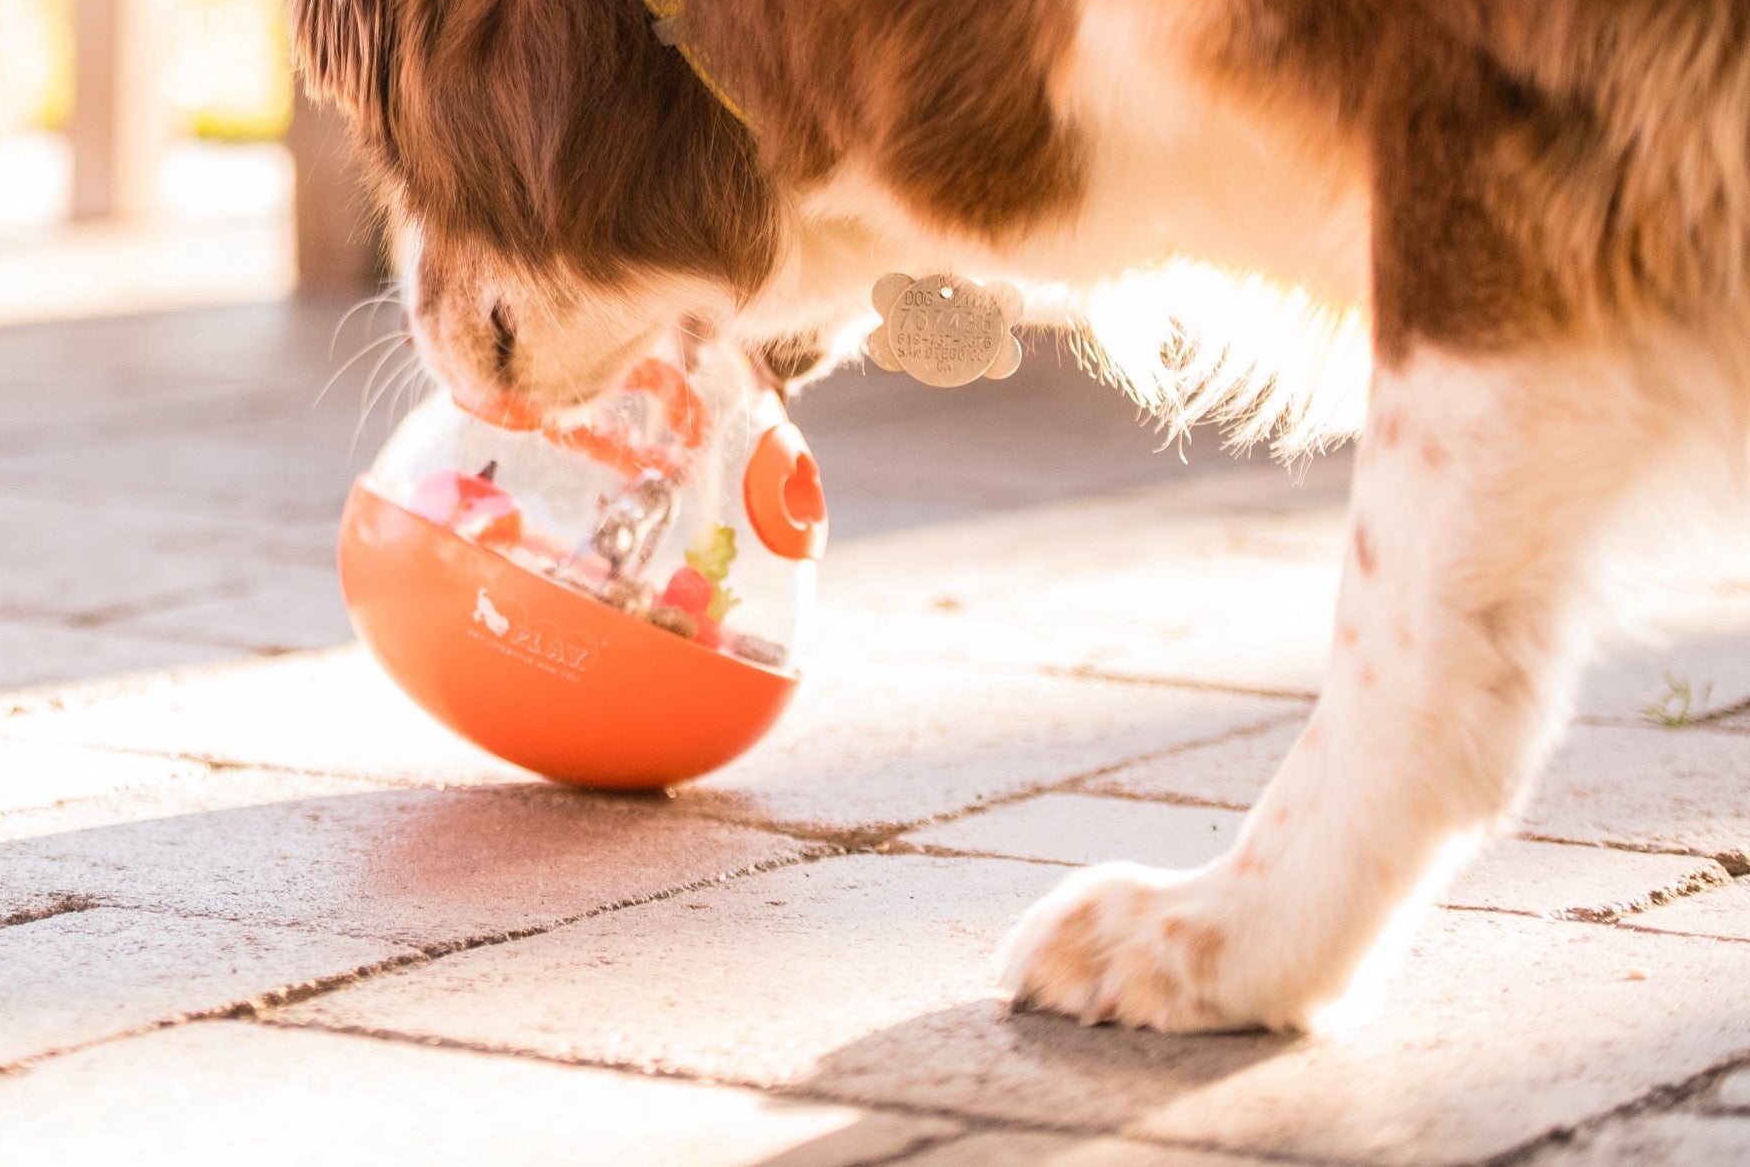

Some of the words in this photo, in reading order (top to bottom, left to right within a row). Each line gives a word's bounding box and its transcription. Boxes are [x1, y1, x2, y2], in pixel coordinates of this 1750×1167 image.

[905, 290, 933, 307] DOG
[898, 346, 921, 358] SAN
[925, 346, 965, 361] DIEGO
[936, 360, 952, 372] CA
